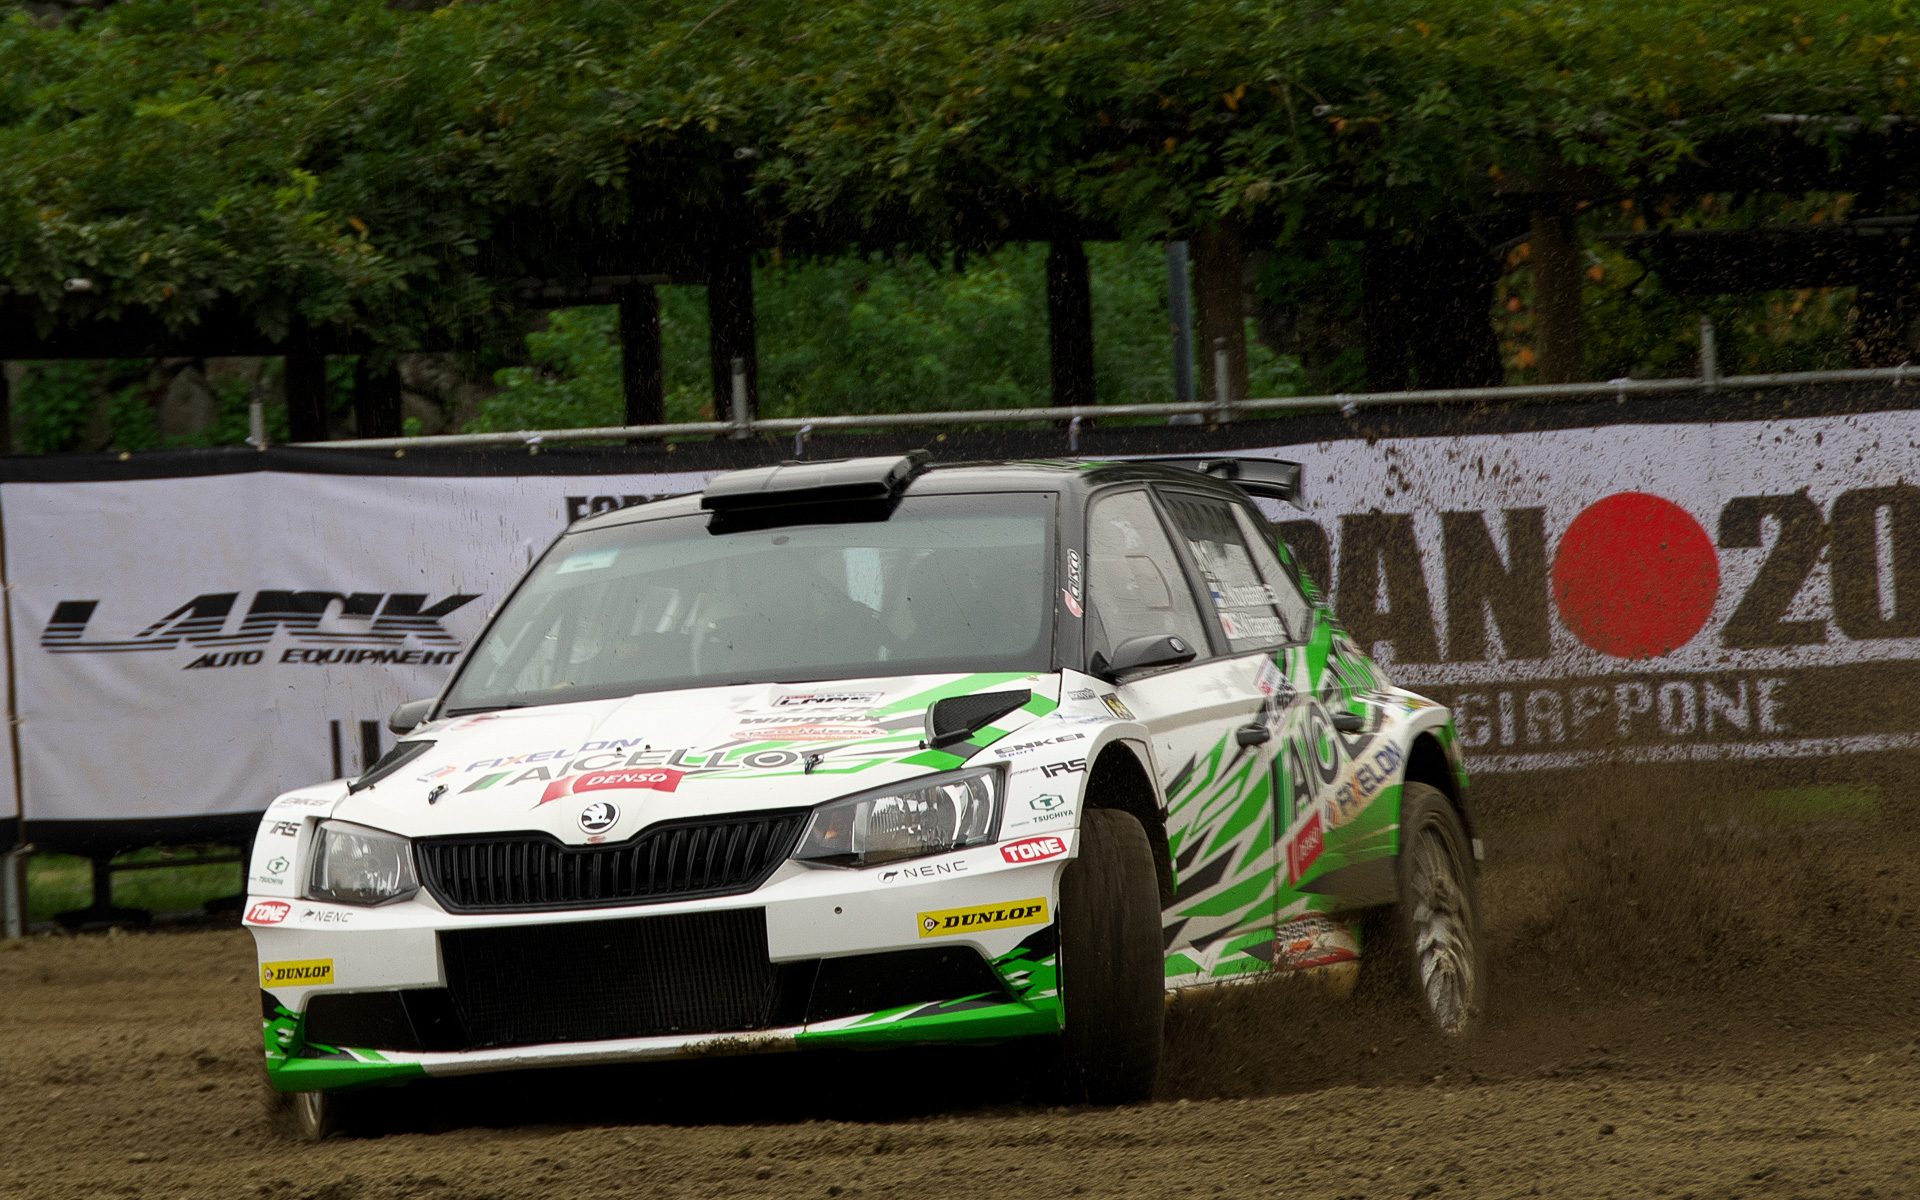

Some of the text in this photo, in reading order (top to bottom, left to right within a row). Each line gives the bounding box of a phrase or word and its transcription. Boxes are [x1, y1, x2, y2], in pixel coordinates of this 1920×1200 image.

[183, 647, 461, 670] AUTO EQUIPMENT
[994, 733, 1085, 755] ENKEI
[464, 737, 643, 773] FIXELON
[586, 773, 668, 785] DENSO
[1033, 809, 1074, 823] TSUCHIYA
[1005, 837, 1062, 862] TONE
[903, 860, 968, 879] NENC
[250, 904, 289, 921] TONE
[314, 911, 354, 923] NENC
[942, 905, 1042, 929] DUNLOP
[275, 966, 331, 980] DUNLOP
